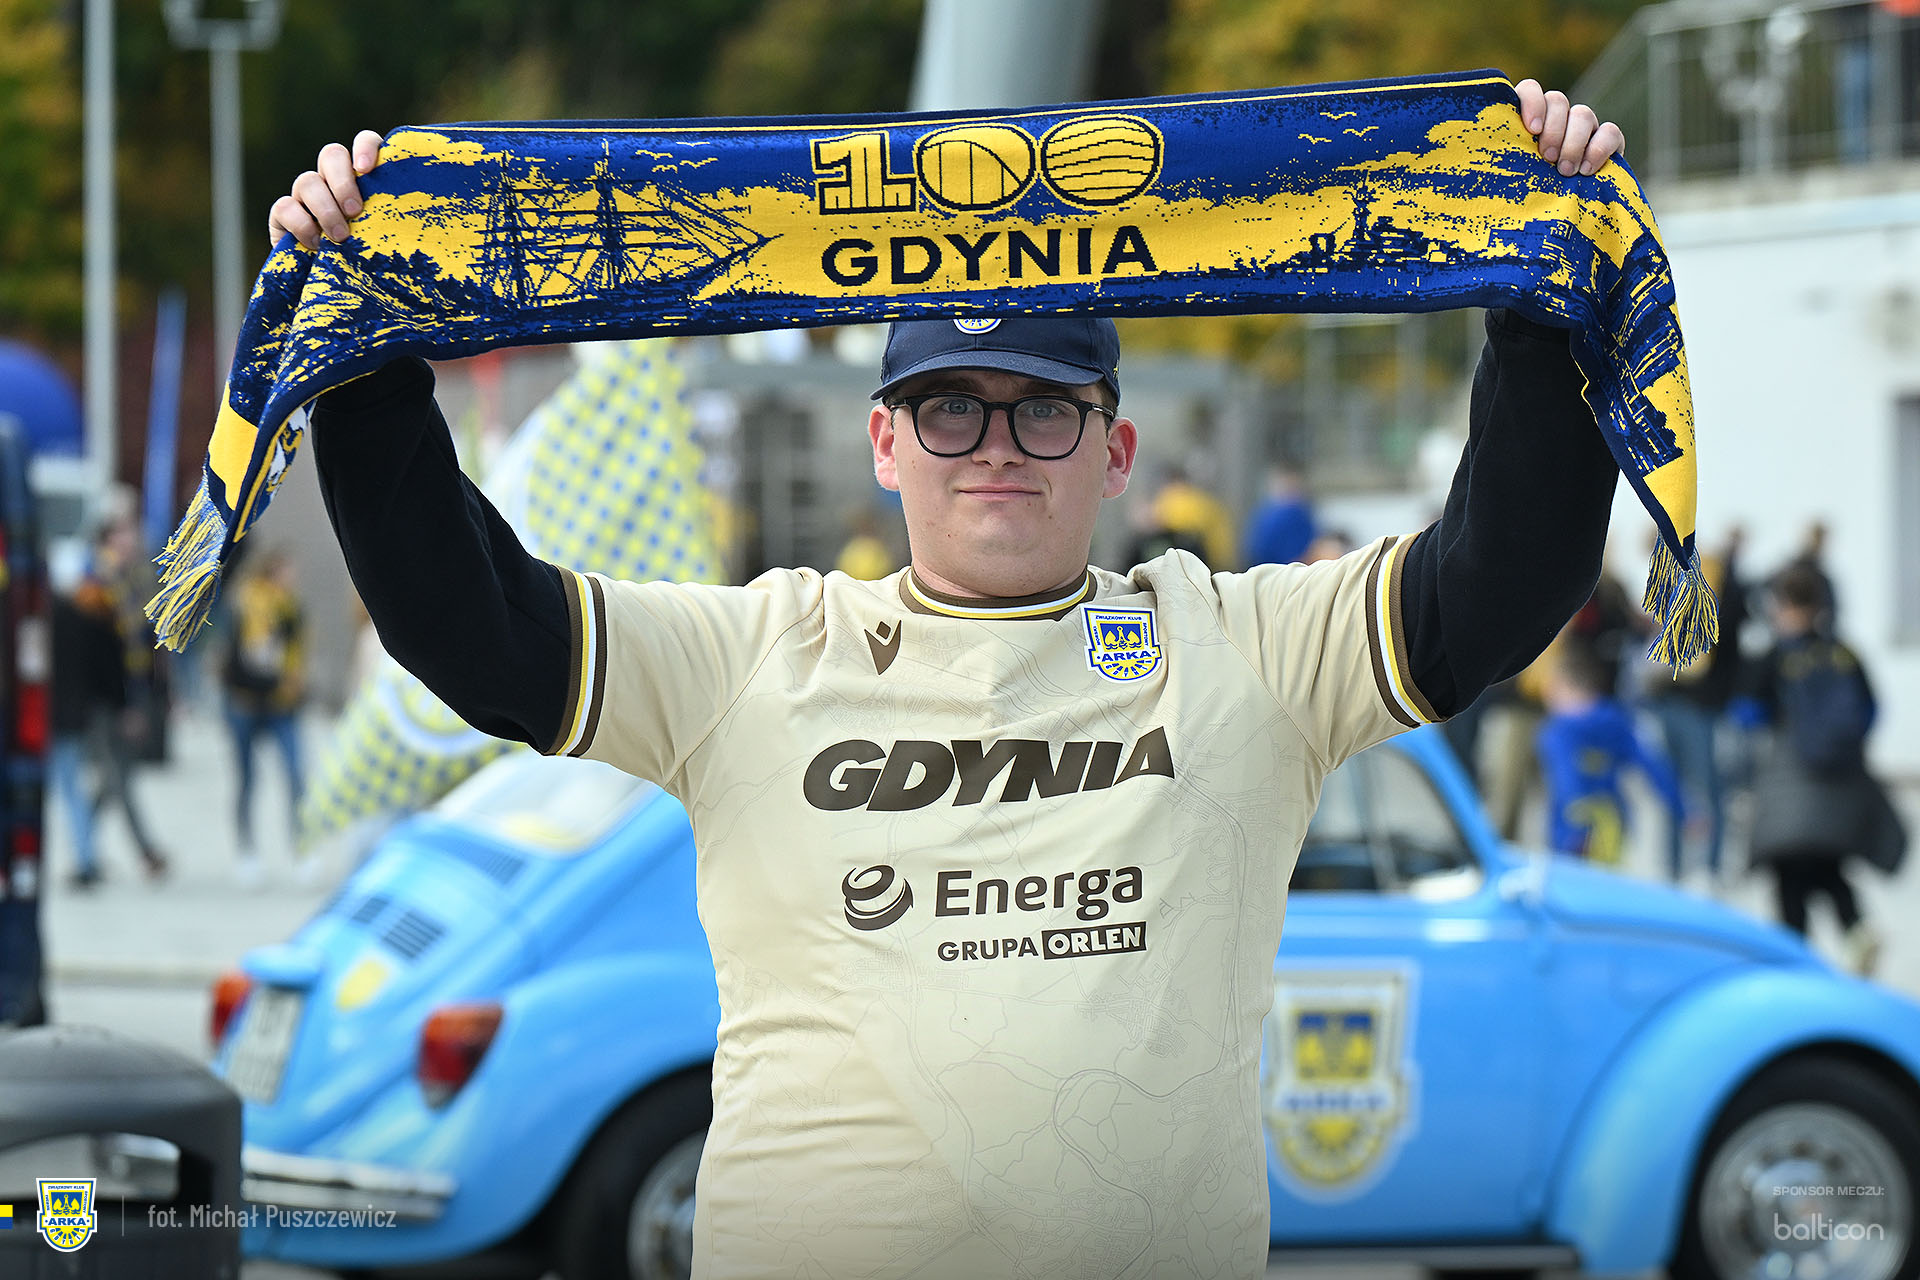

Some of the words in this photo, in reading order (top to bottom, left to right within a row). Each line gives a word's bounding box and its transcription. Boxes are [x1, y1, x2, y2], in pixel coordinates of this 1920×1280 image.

[809, 113, 1165, 215] 100
[821, 225, 1159, 287] GDYNIA
[1102, 651, 1152, 662] ARKA
[803, 726, 1175, 812] GDYNIA
[934, 865, 1144, 921] Energa
[937, 937, 1039, 962] GRUPA
[1046, 925, 1142, 956] ORLEN
